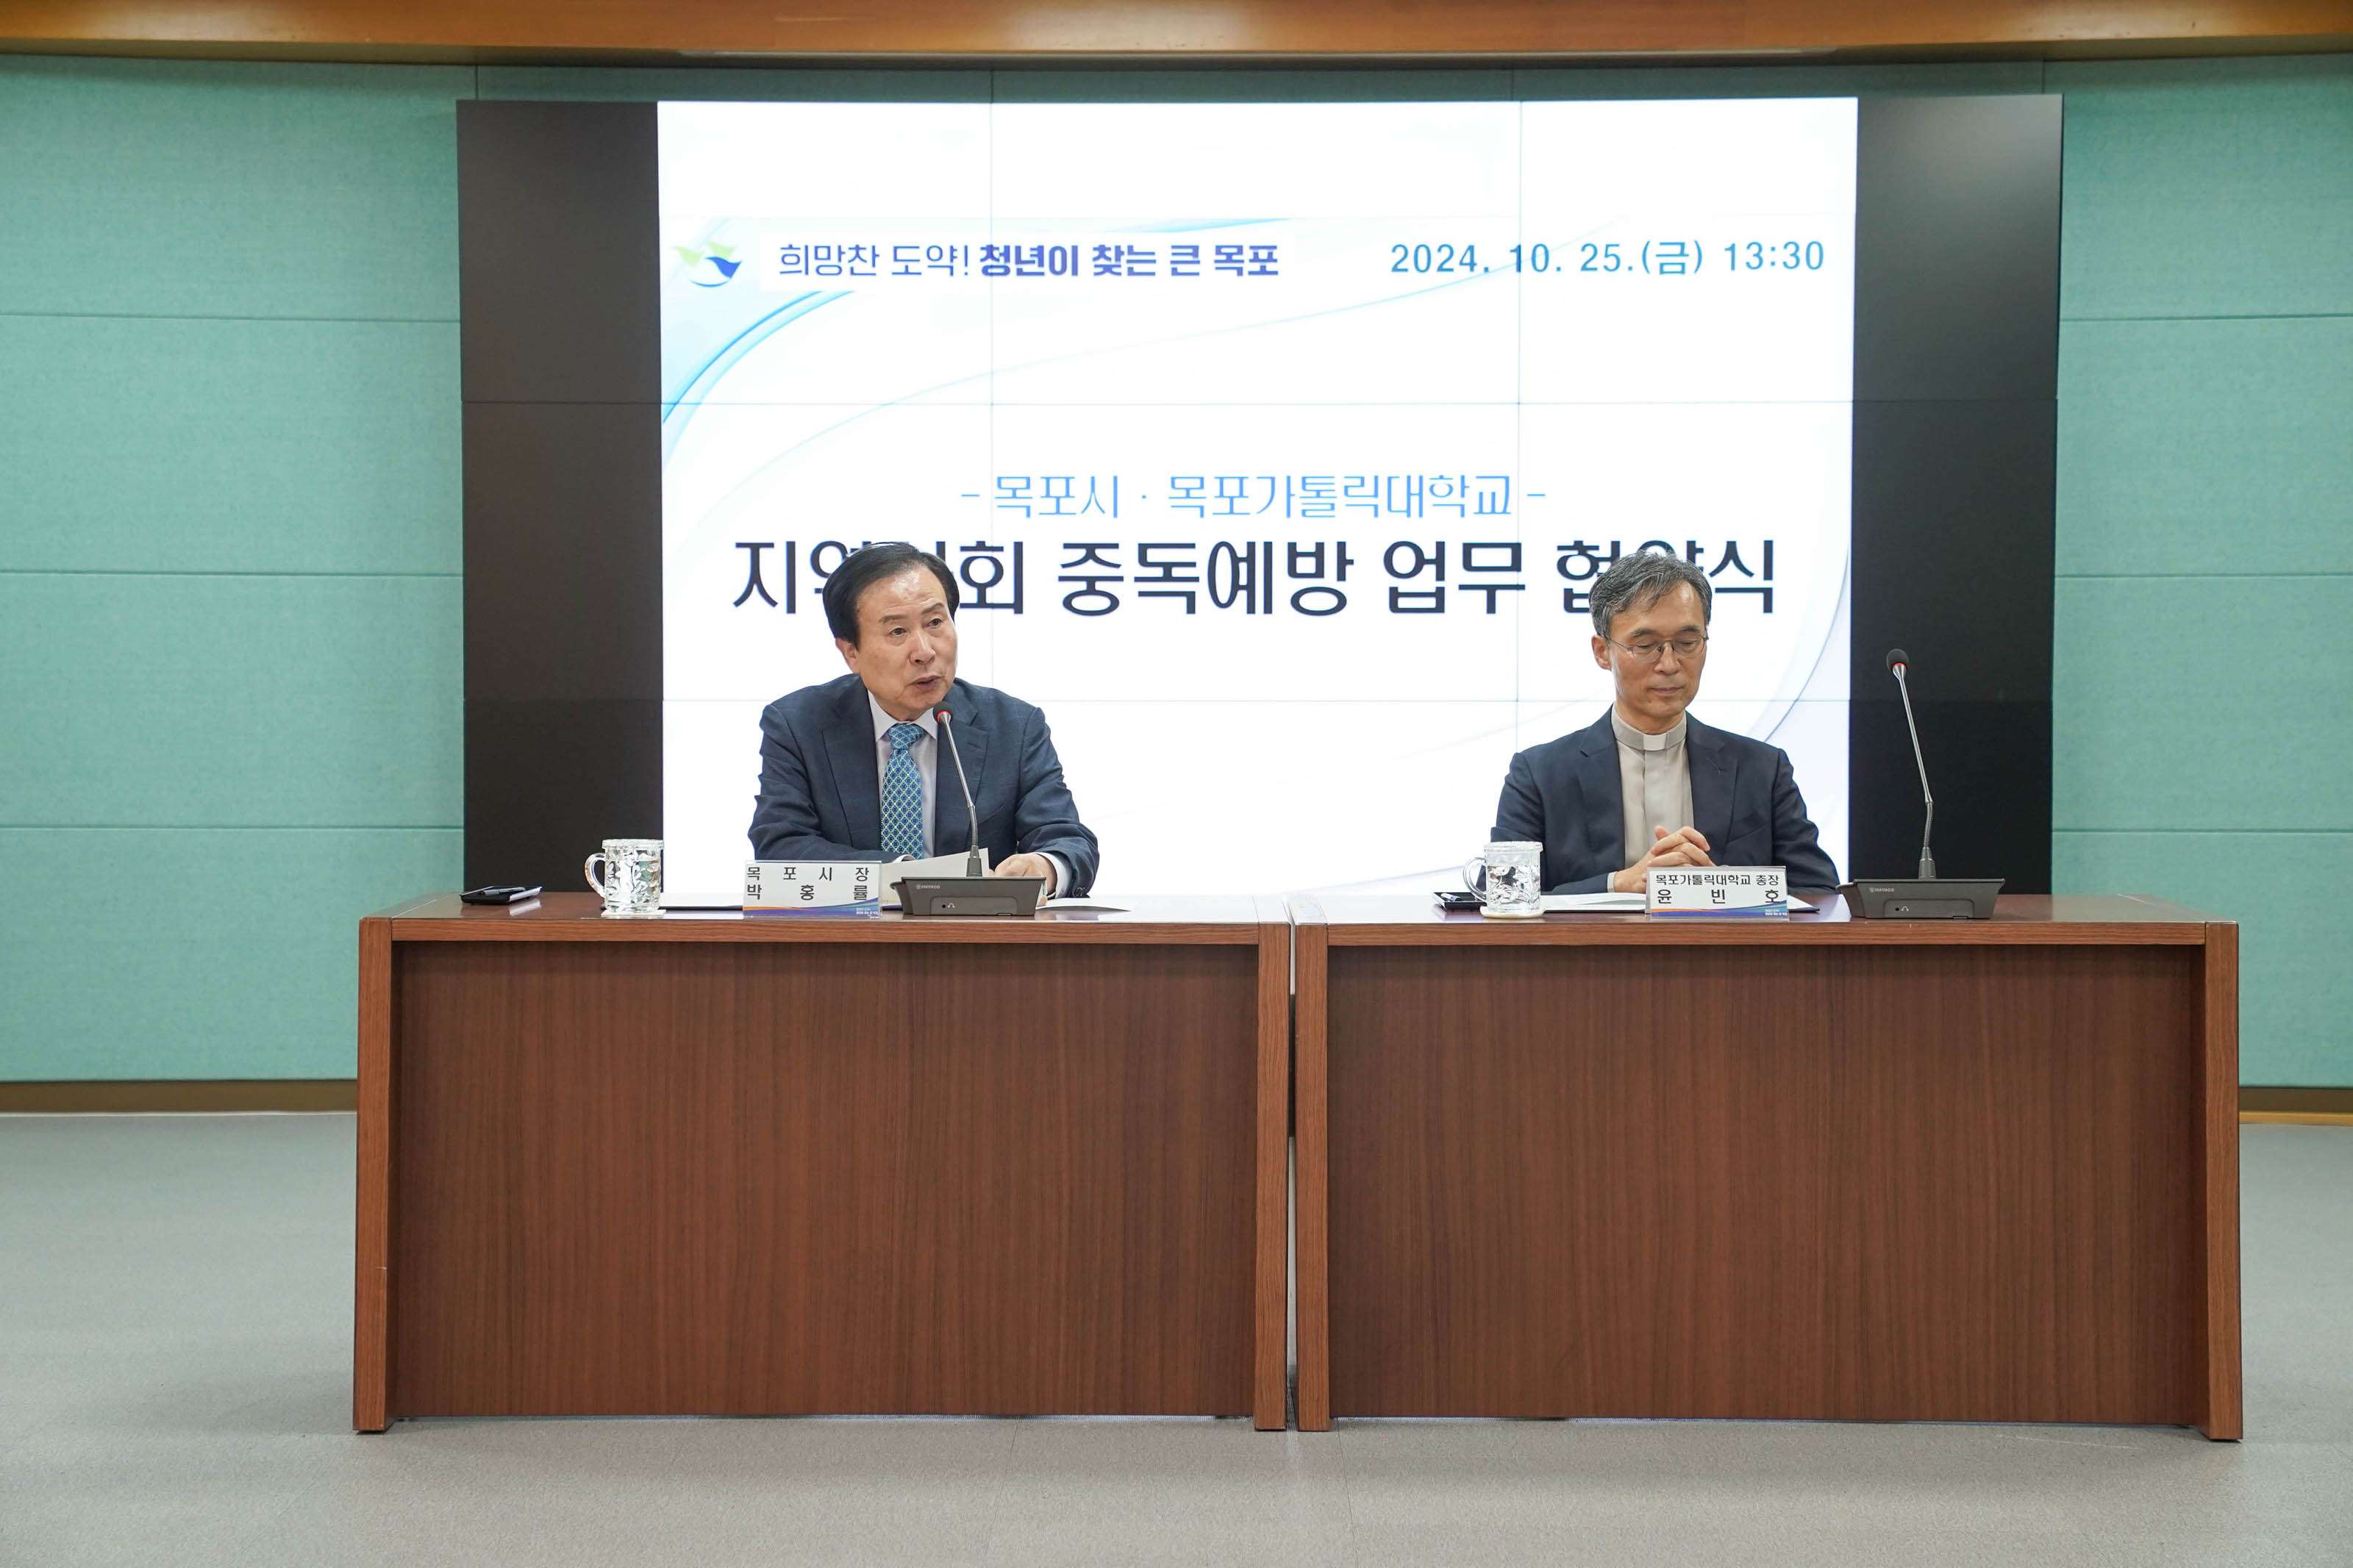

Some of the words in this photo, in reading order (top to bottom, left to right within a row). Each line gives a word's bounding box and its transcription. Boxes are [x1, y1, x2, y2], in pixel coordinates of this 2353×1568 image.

[779, 243, 880, 277] 희망찬
[891, 243, 969, 277] 도약!
[979, 243, 1079, 277] 청년이
[1092, 243, 1157, 277] 찾는
[1170, 244, 1201, 276] 큰
[1213, 243, 1279, 277] 목포
[1391, 244, 1490, 273] 2024.
[1510, 244, 1562, 273] 10.
[1724, 240, 1824, 271] 13:30
[995, 475, 1118, 518] 목포시
[1168, 474, 1512, 518] 목포가톨릭대학교
[732, 540, 1024, 615] 지회
[1057, 540, 1354, 617] 중독예방
[1383, 540, 1526, 615] 업무
[1656, 874, 1751, 886] 목포가톨릭대학교
[1756, 875, 1779, 886] 총장
